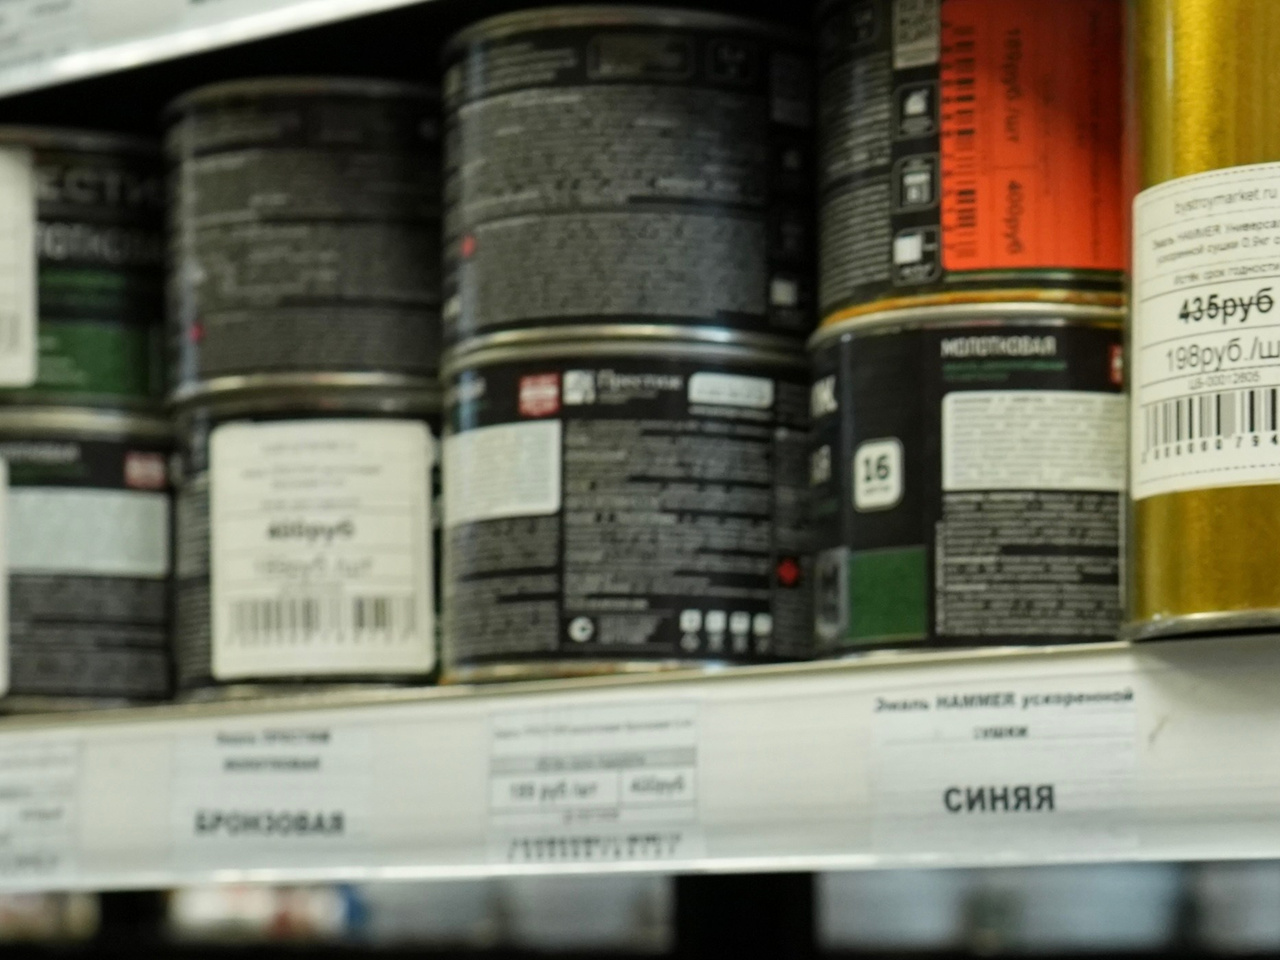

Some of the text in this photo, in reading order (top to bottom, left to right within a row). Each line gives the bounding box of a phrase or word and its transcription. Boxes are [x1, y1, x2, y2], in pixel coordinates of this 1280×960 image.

[1228, 261, 1280, 277] годности
[1177, 287, 1275, 325] 435руб
[862, 454, 890, 483] 16
[935, 691, 1017, 711] HAMMER
[1020, 686, 1134, 709] ускоренной
[943, 784, 1056, 813] СИНЯЯ
